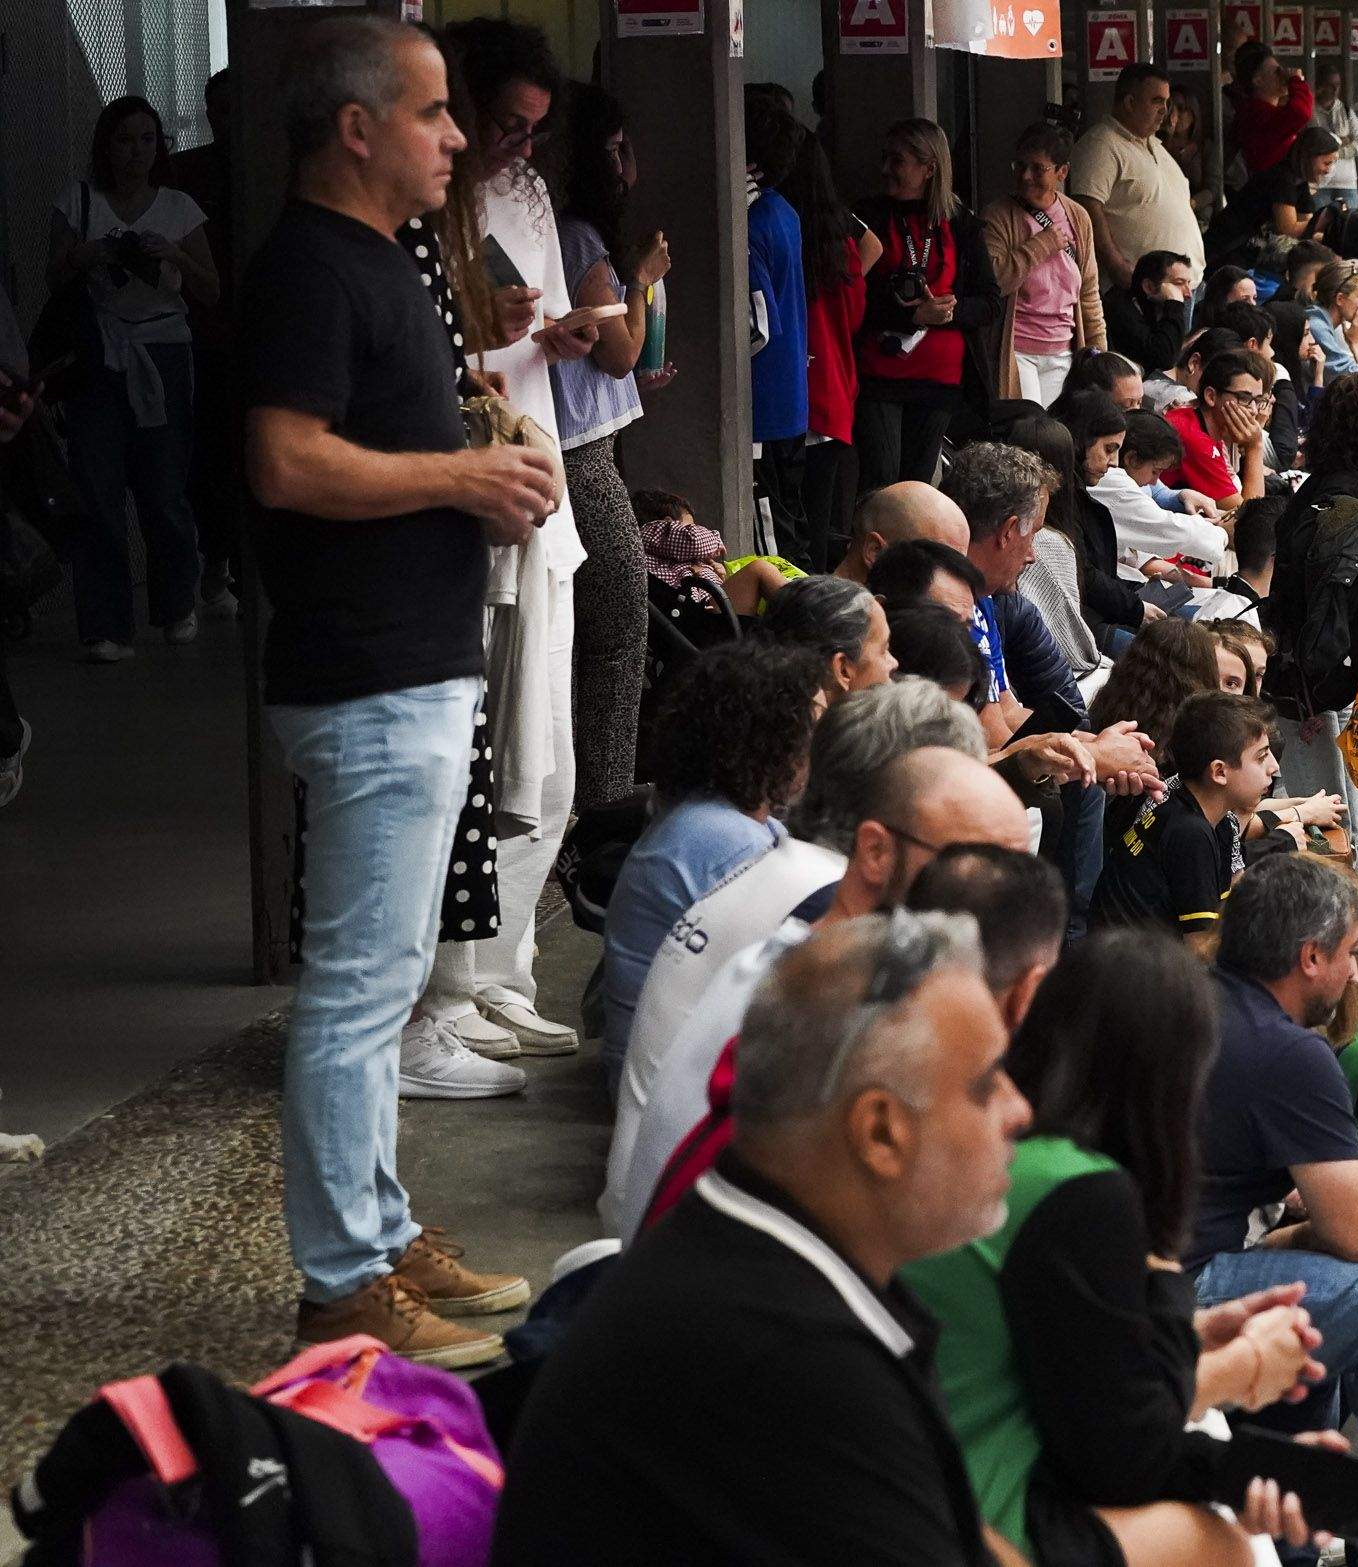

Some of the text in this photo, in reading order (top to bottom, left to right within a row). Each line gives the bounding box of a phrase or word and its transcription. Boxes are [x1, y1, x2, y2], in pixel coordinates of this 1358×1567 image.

[1174, 24, 1202, 54] A
[1274, 18, 1297, 41] A
[1315, 21, 1336, 42] A
[1096, 27, 1129, 61] A
